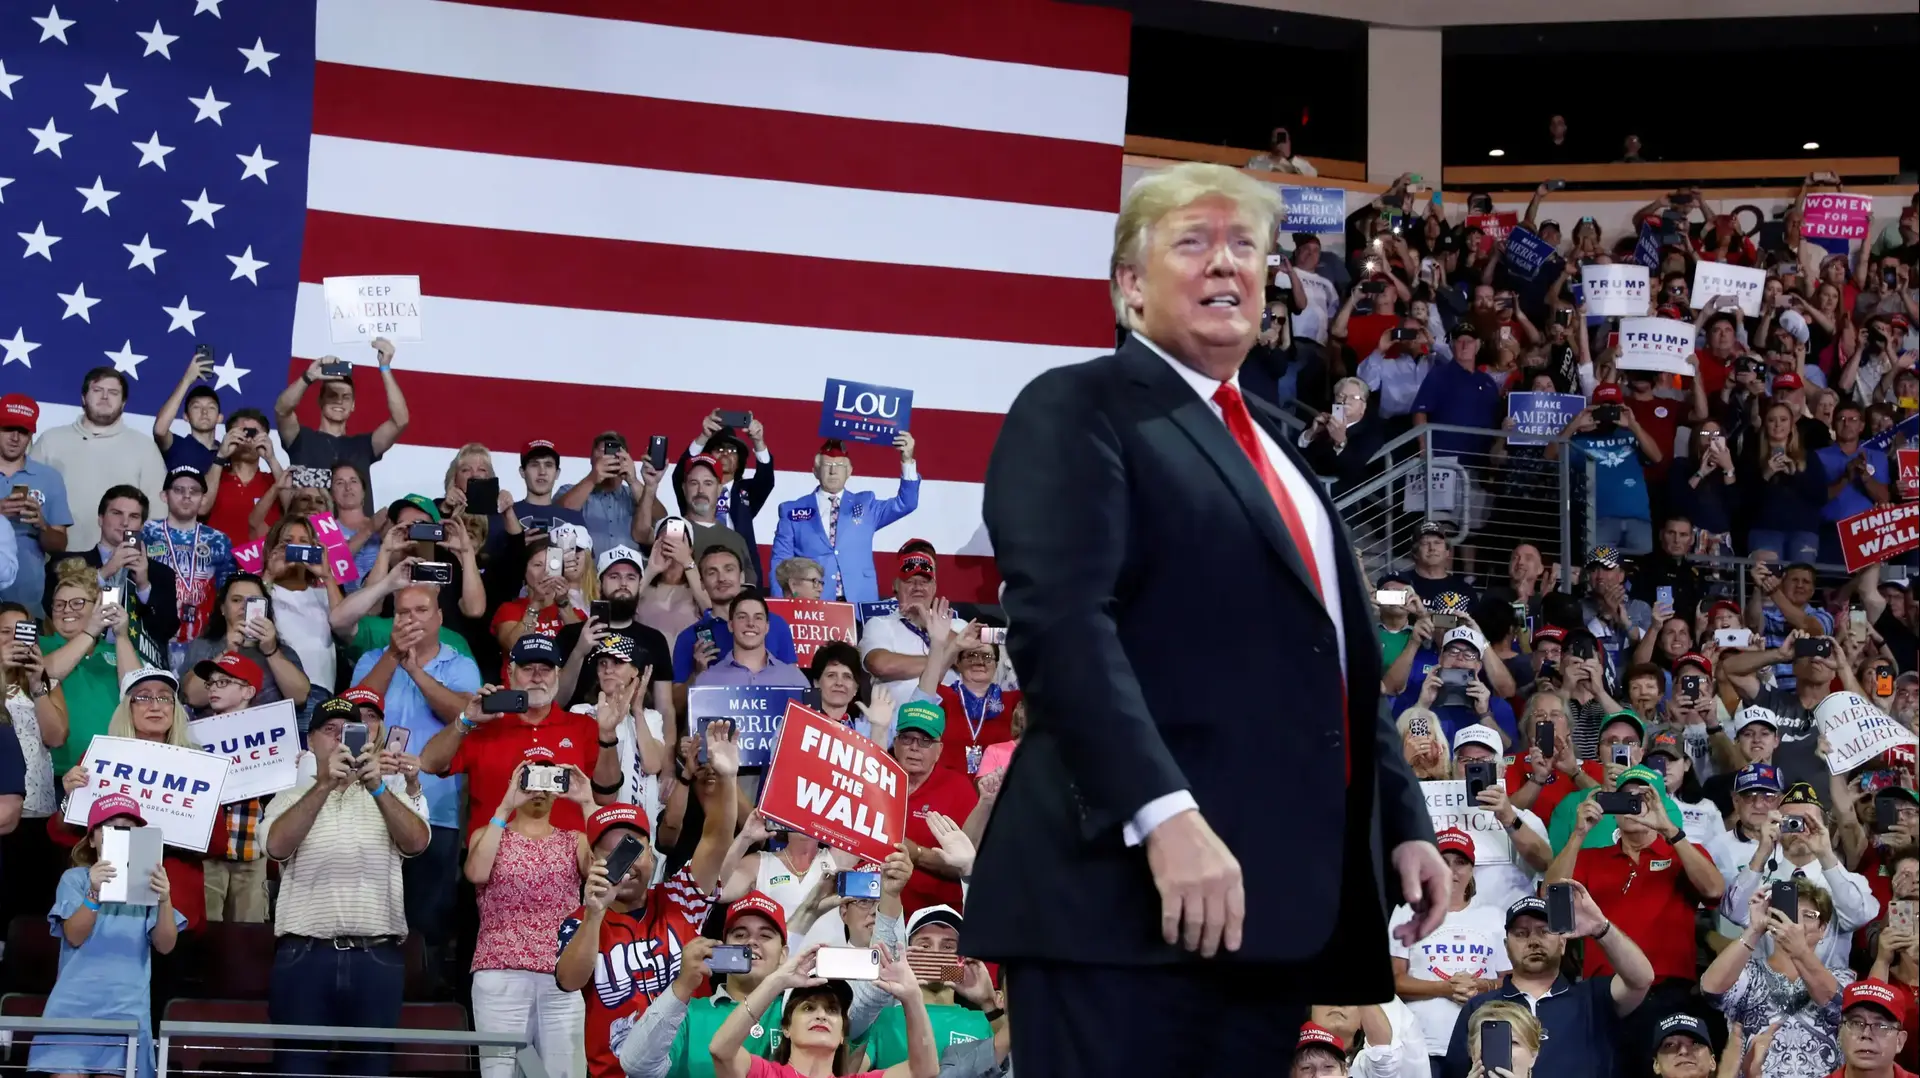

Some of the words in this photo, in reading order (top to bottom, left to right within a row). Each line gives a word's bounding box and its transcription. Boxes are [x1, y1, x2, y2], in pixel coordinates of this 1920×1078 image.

[1807, 198, 1871, 212] WOMEN
[1287, 216, 1309, 225] SAFE
[1310, 216, 1337, 225] AGAIN
[1824, 212, 1848, 222] FOR
[1806, 223, 1864, 236] TRUMP
[1588, 279, 1645, 289] TRUMP
[358, 286, 391, 297] KEEP
[358, 322, 398, 334] GREAT
[1626, 332, 1689, 346] TRUMP
[1631, 343, 1683, 353] PENCE
[835, 384, 900, 418] LOU
[1535, 400, 1561, 409] MAKE
[1512, 411, 1573, 425] AMERIC
[1518, 425, 1543, 435] SAFE
[171, 465, 200, 475] TRUMP
[791, 508, 812, 517] LOU
[1850, 505, 1919, 536] FINISH
[1874, 523, 1896, 536] THE
[1858, 525, 1919, 558] WALL
[609, 550, 633, 560] USA
[794, 610, 825, 621] MAKE
[789, 624, 855, 647] ERICA
[1452, 630, 1474, 640] USA
[729, 699, 768, 710] MAKE
[1744, 709, 1769, 720] USA
[202, 726, 286, 754] RUMP
[231, 745, 279, 765] NCE
[800, 724, 896, 798] FINISH
[241, 763, 261, 772] GREAT
[94, 759, 211, 795] TRUMP
[831, 771, 864, 798] THE
[98, 779, 194, 808] PENCE
[145, 804, 169, 813] GREAT
[171, 807, 196, 819] AGAIN!
[595, 811, 612, 820] MAKE
[796, 776, 889, 845] WALL
[599, 815, 616, 824] GREAT
[1431, 813, 1504, 831] ERICA
[732, 900, 748, 910] MAKE
[750, 897, 777, 910] AMERICA
[734, 902, 753, 912] GREAT
[755, 902, 774, 913] AGAIN
[1421, 944, 1493, 956] TRUMP
[1429, 955, 1488, 964] PENCE
[1869, 985, 1895, 999] AMERICA
[1873, 991, 1892, 1002] AGAIN
[1660, 1016, 1674, 1026] MAKE
[1675, 1014, 1698, 1024] AMERICA
[1661, 1020, 1679, 1031] GREAT
[1680, 1020, 1698, 1028] AGAIN
[1308, 1029, 1335, 1038] AMERICA
